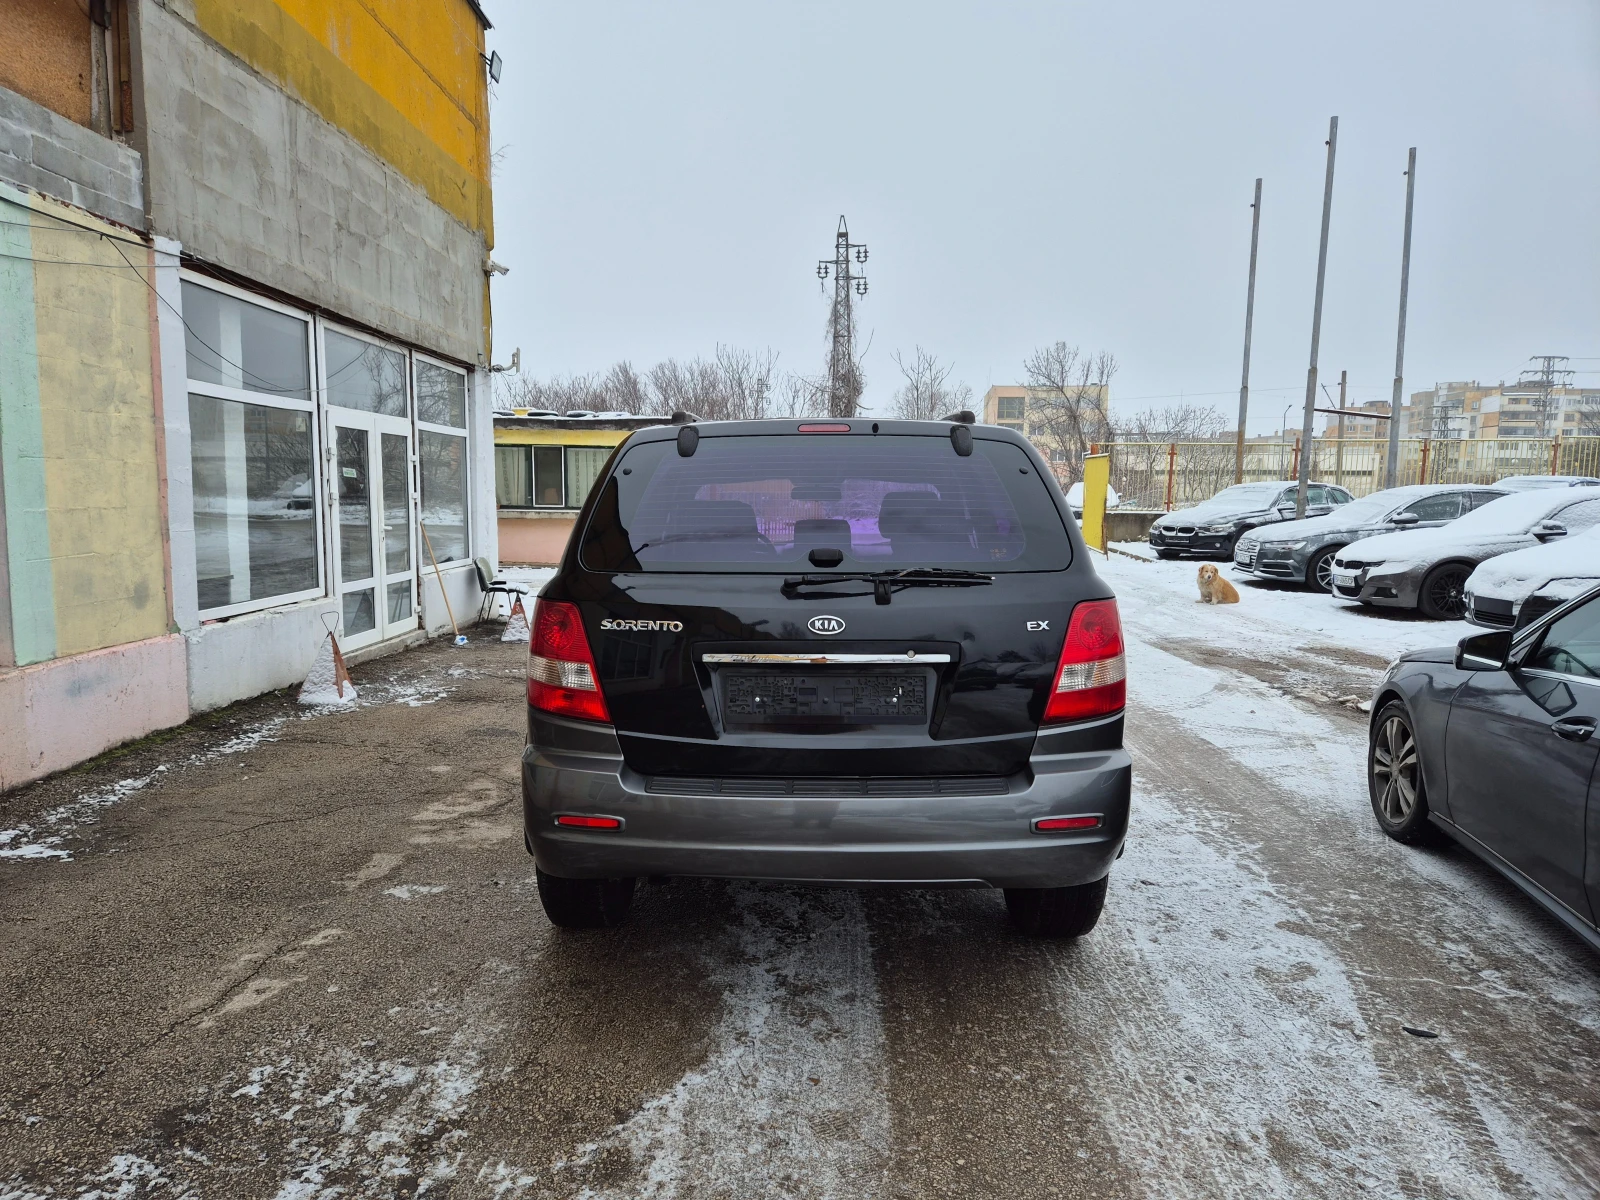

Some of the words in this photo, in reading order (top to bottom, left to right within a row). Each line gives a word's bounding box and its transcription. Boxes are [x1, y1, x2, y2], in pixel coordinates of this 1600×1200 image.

[600, 618, 683, 632] SORENTO
[814, 619, 839, 631] KIA
[1026, 620, 1050, 631] EX
